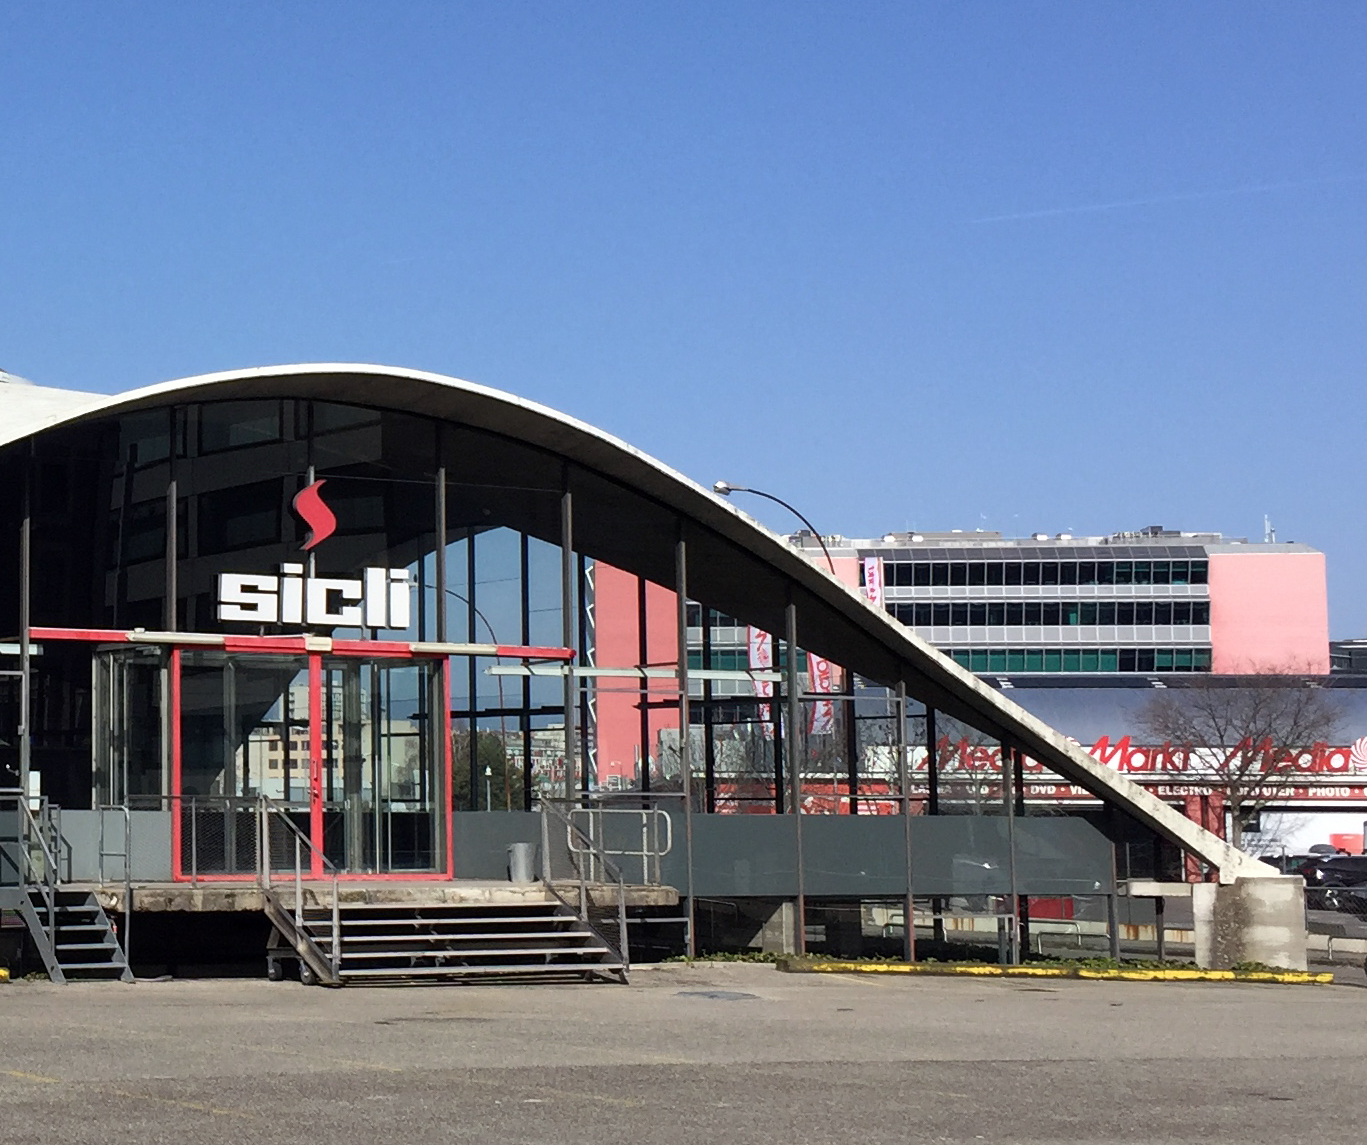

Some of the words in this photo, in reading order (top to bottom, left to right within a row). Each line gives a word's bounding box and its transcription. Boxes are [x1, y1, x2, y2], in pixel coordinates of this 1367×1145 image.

[218, 562, 411, 628] sicli
[916, 735, 1044, 772] Meda
[1089, 735, 1193, 772] Markt
[1218, 736, 1351, 772] Media
[1030, 785, 1056, 795] DVD
[1157, 785, 1213, 796] ELECTRO
[1308, 786, 1351, 796] PHOTO
